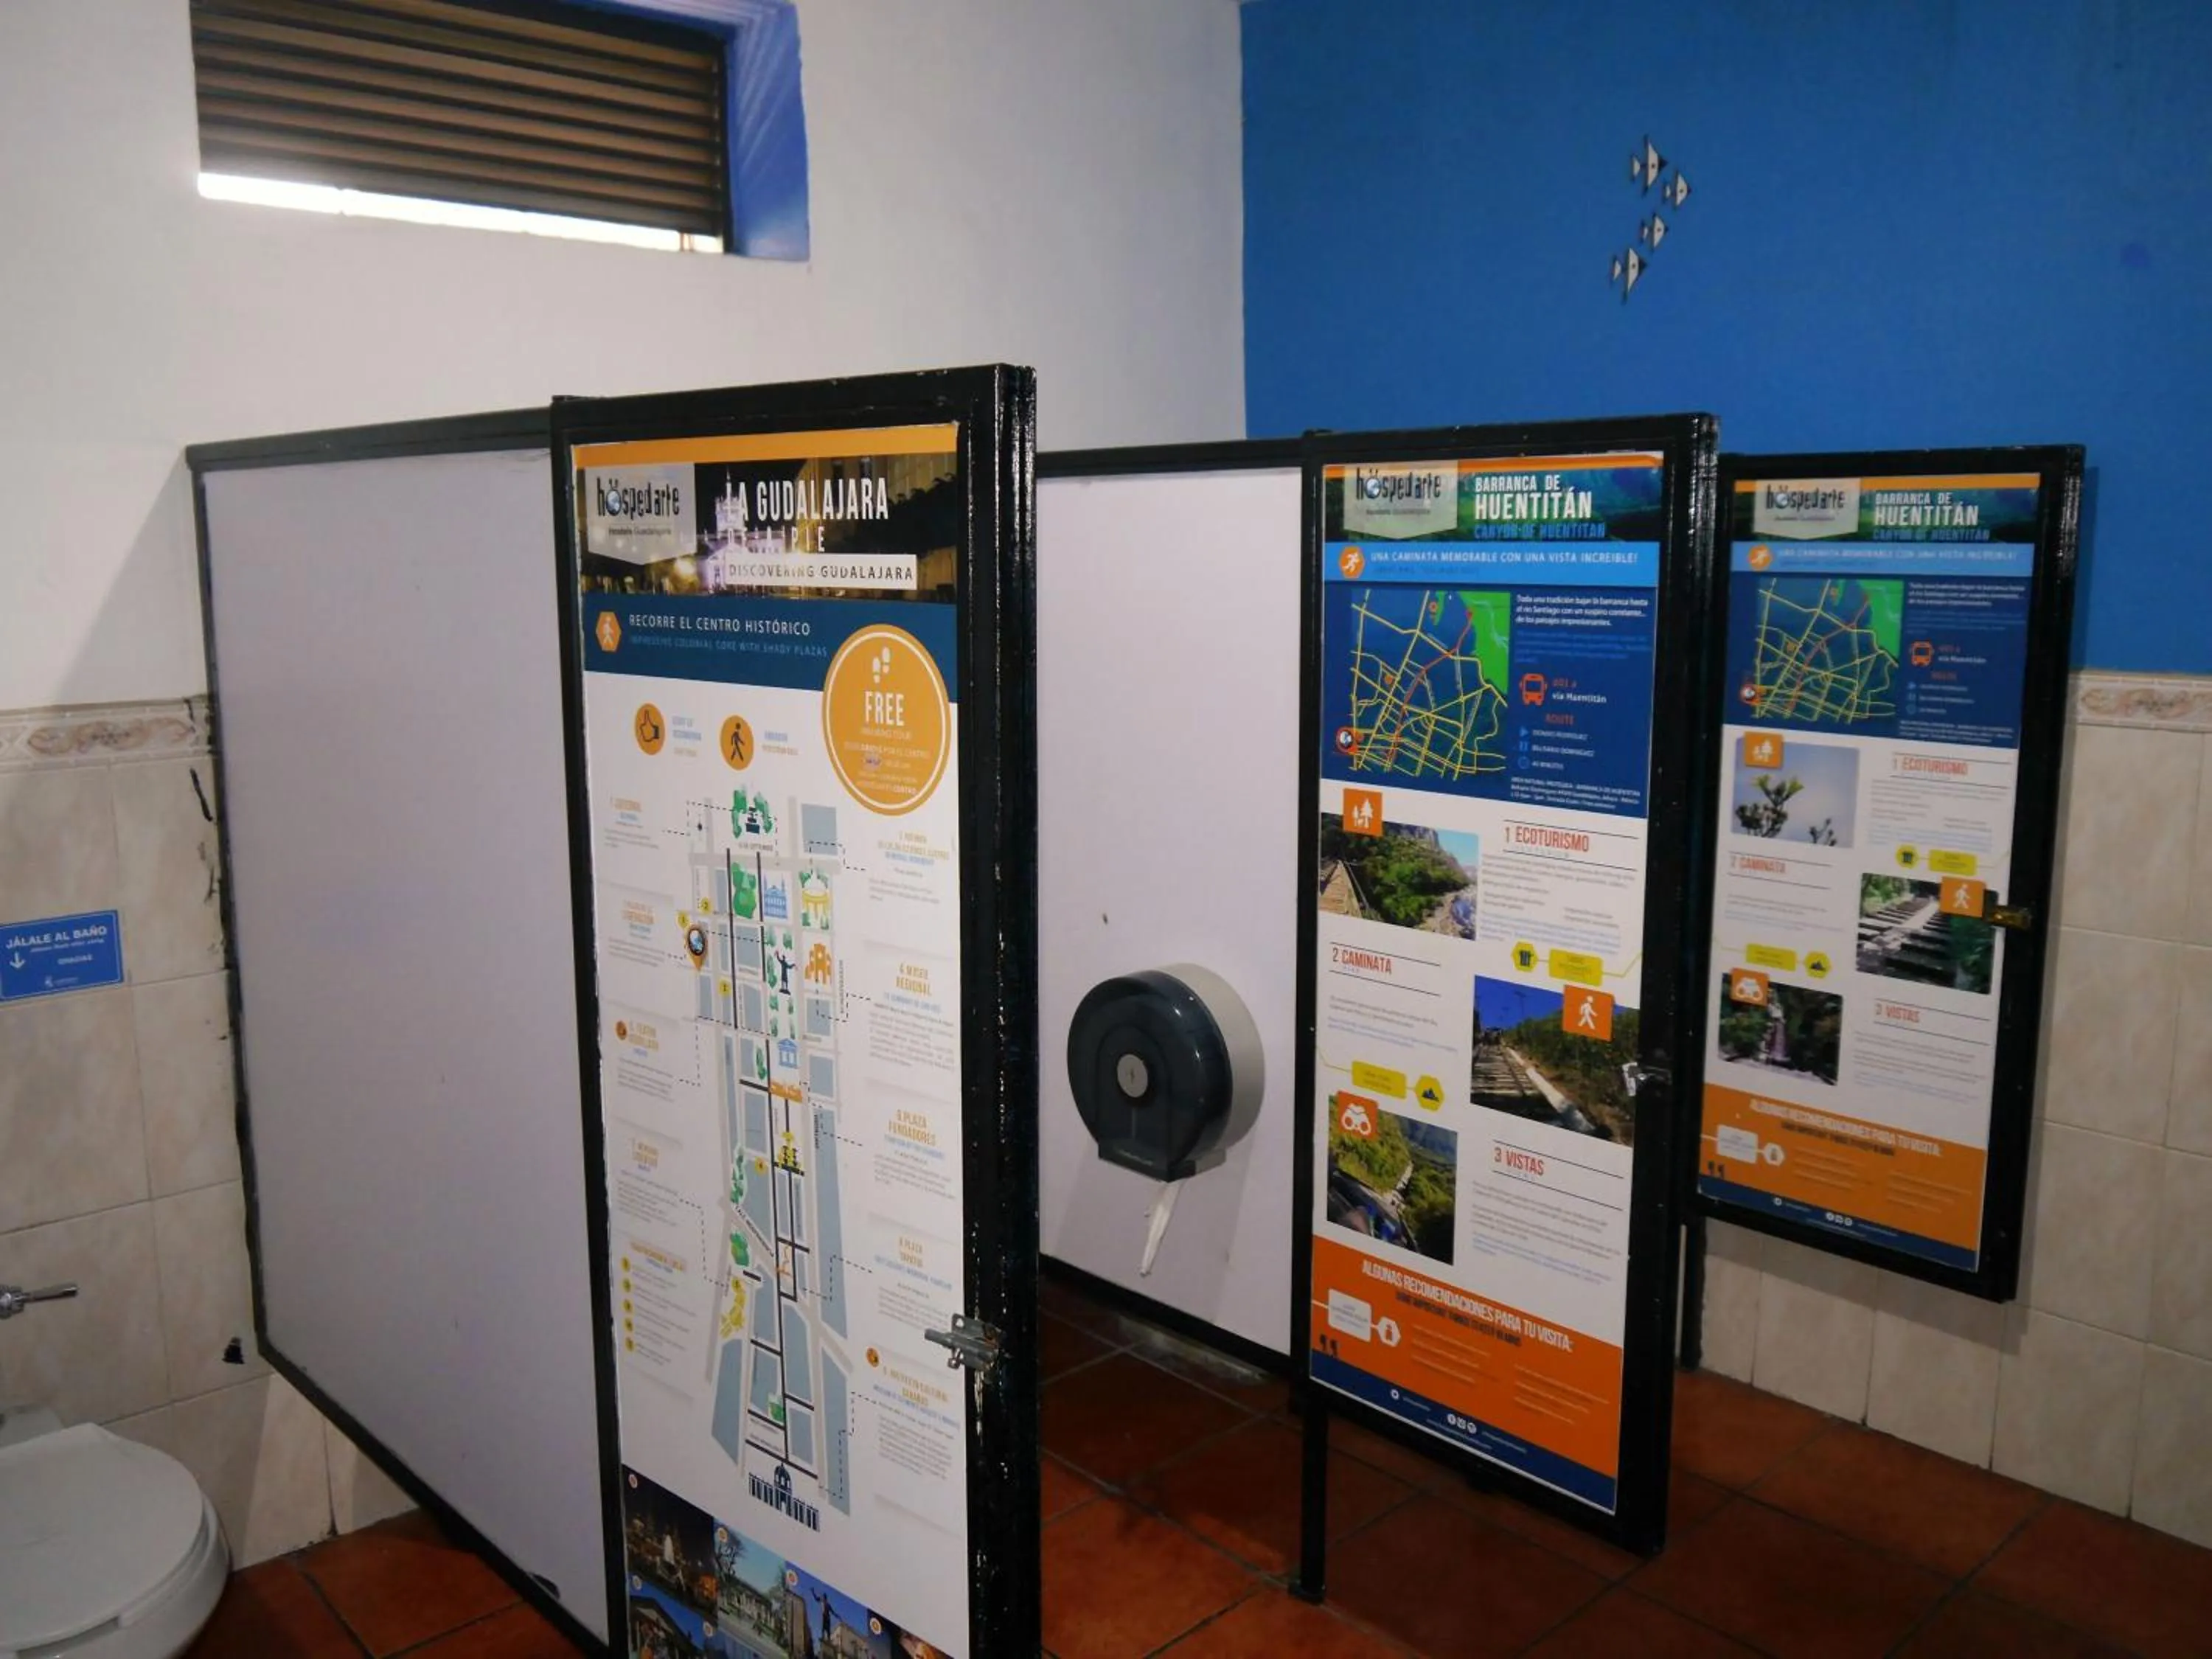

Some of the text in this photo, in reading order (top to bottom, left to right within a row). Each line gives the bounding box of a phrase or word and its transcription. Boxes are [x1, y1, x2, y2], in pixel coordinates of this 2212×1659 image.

[1475, 474, 1561, 492] BARRANCA DE
[757, 477, 889, 521] GUDALAJARA
[1475, 486, 1593, 521] HUENTITÁN
[1874, 491, 1953, 505] BARRANCA DE
[1874, 501, 1979, 526] HUENTITÁN
[1392, 552, 1438, 563] CAMINATA
[1440, 552, 1498, 563] MEMORABLE
[1500, 552, 1521, 563] CON
[1525, 552, 1545, 563] UNA
[1548, 552, 1577, 564] VISTA
[728, 563, 914, 580] DISCOVERING GUDALAJARA
[628, 613, 811, 636] RECORRE EL CENTRO HISTÓRICO
[864, 690, 905, 727] FREE
[1504, 826, 1590, 852] 1 ECOTURISMO
[5, 933, 52, 950] JÁLALE
[55, 931, 71, 943] AL
[72, 924, 108, 939] BAÑO
[1332, 947, 1392, 974] 2 CAMINATA
[1494, 1147, 1545, 1176] 3 VISTAS
[1495, 1308, 1521, 1335] PARA
